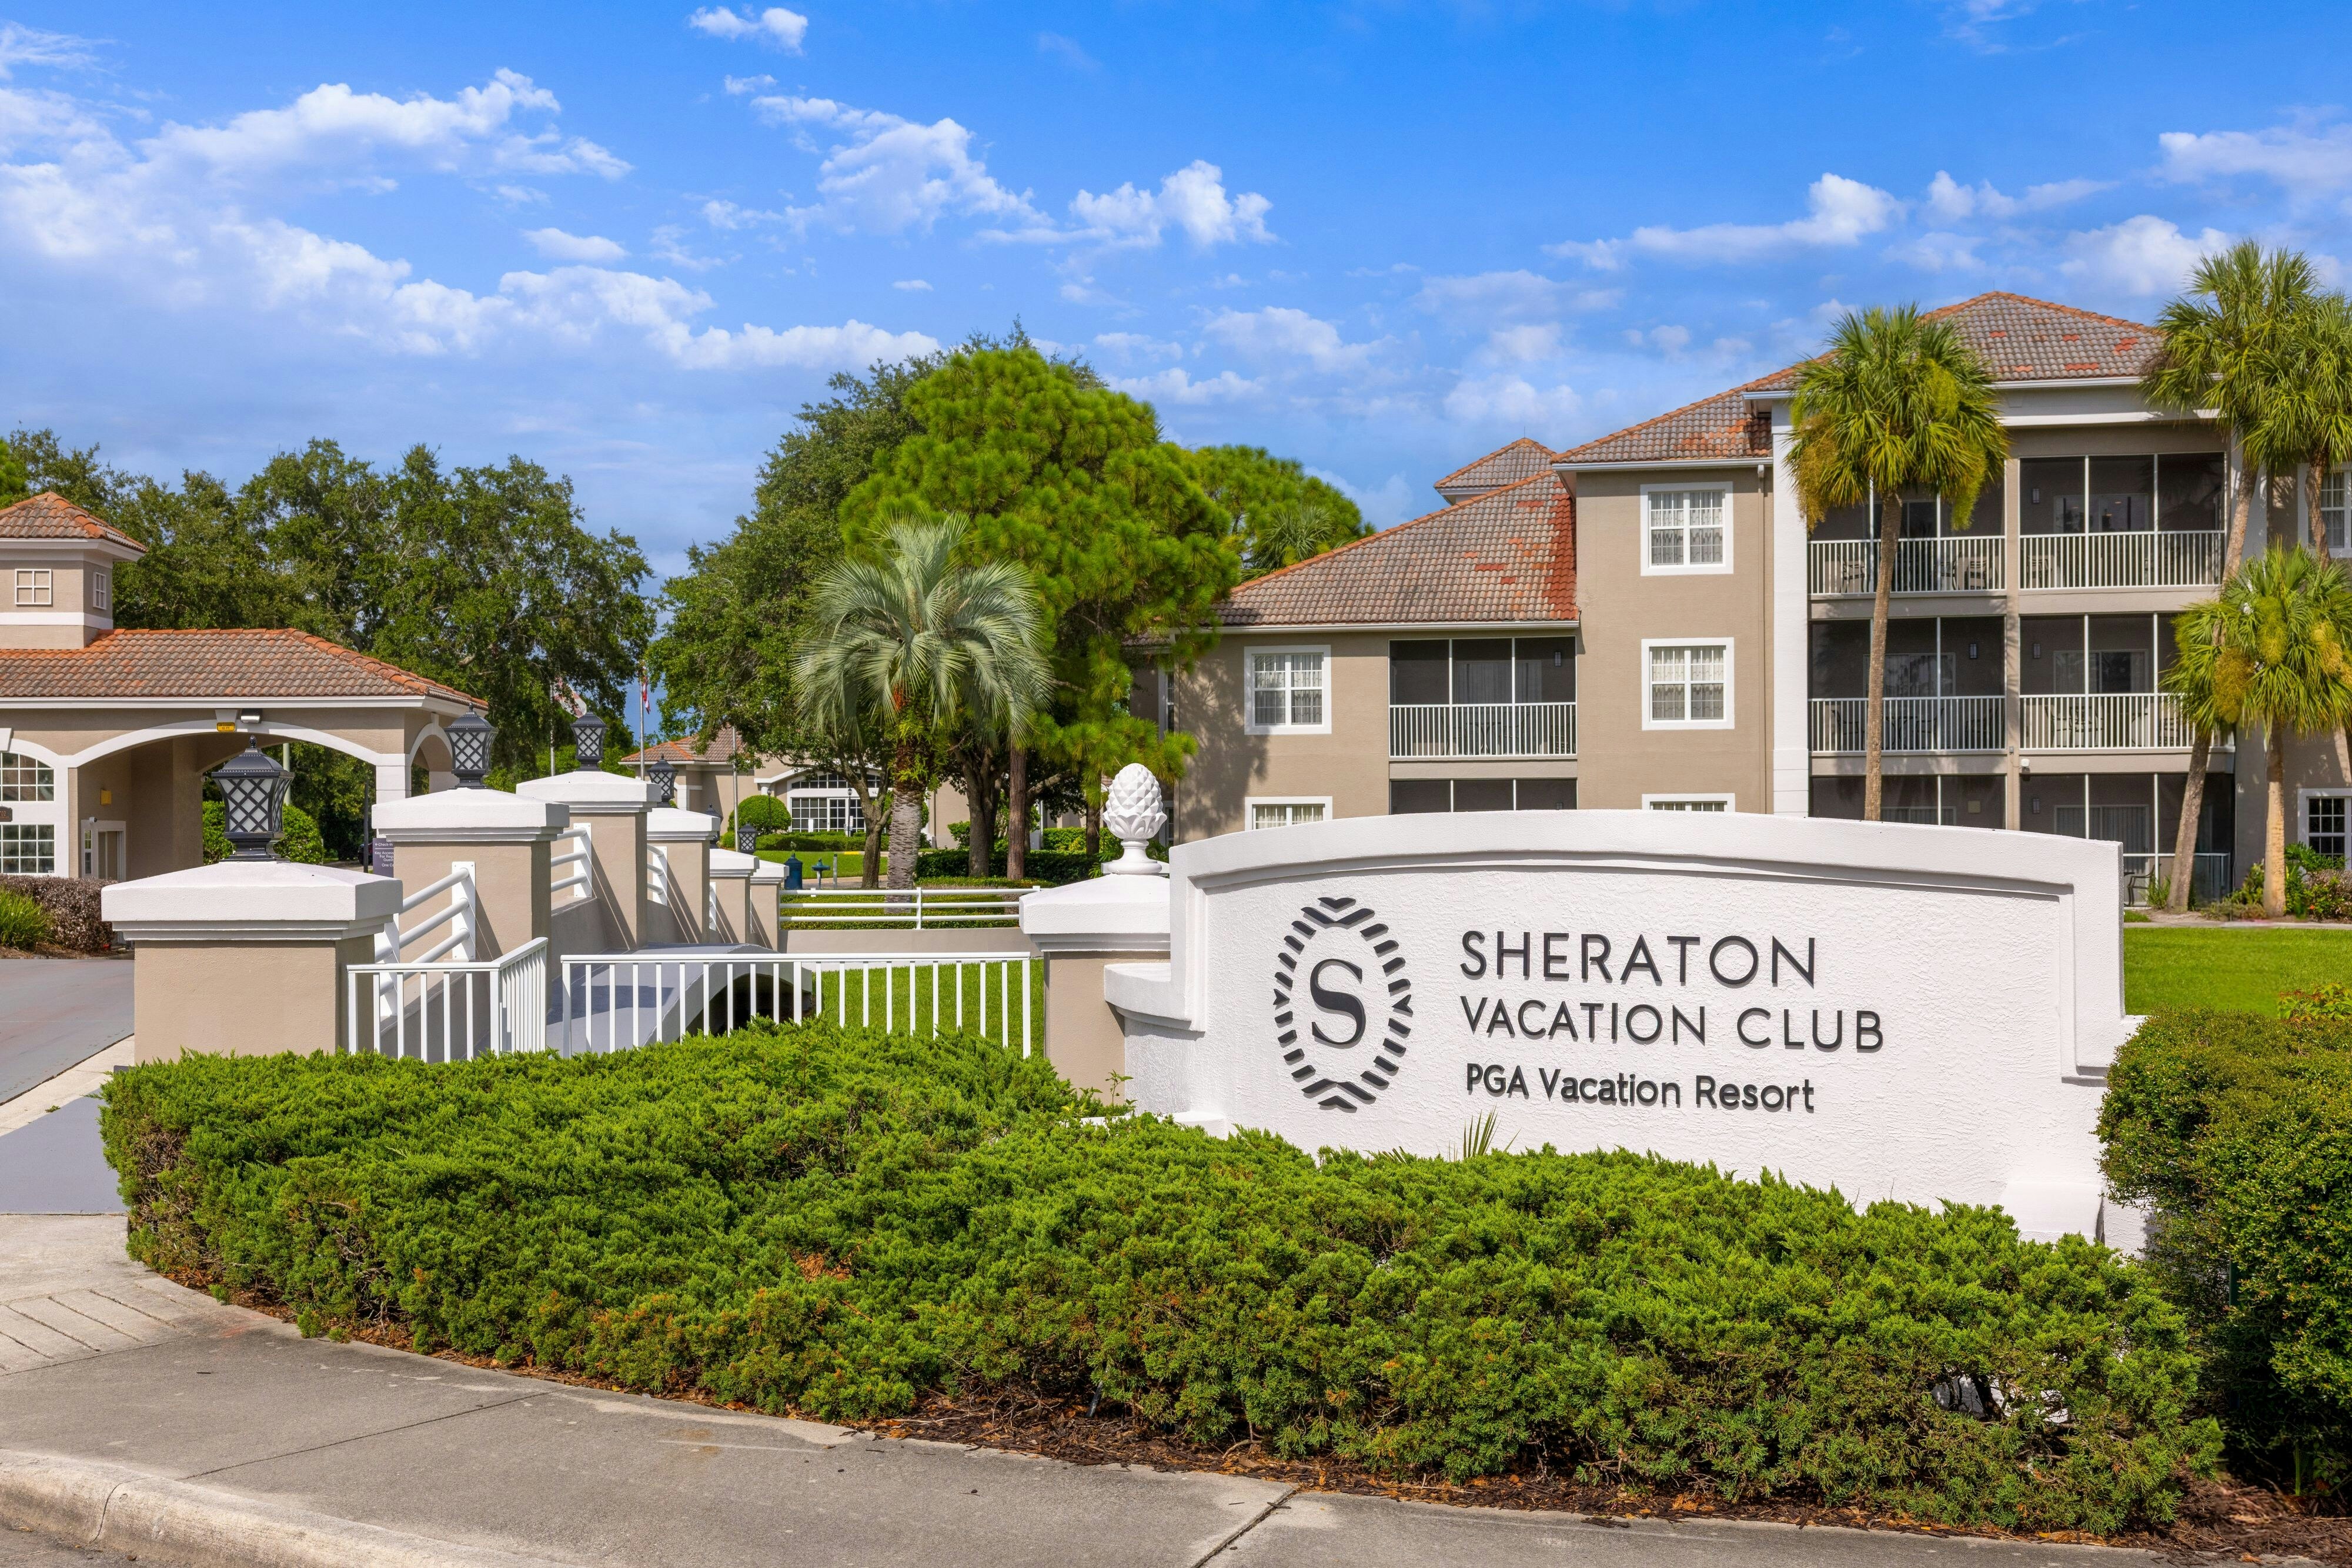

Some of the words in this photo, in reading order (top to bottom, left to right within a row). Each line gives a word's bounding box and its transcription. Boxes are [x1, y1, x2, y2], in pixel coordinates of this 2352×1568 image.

[1460, 930, 1816, 988] SHERATON
[1309, 958, 1367, 1048] S
[1459, 995, 1706, 1045] VACATION
[1736, 1007, 1884, 1053] CLUB
[1466, 1063, 1529, 1099] PGA
[1538, 1068, 1681, 1107] Vacation
[1696, 1075, 1815, 1114] Resort
